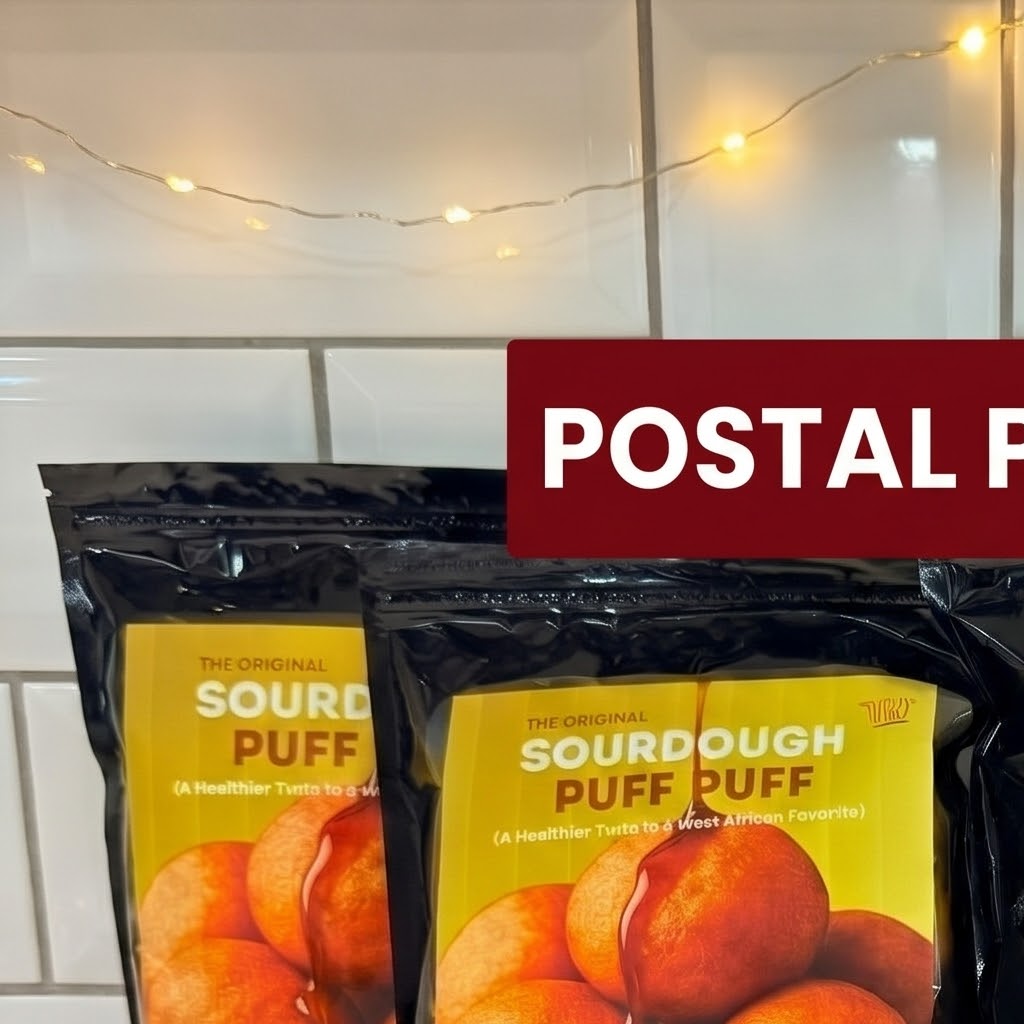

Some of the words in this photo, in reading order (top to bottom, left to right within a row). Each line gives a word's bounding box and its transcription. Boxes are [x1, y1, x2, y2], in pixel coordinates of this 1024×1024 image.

[200, 657, 232, 672] THE
[238, 657, 327, 673] ORIGINAL
[528, 717, 559, 730] THE
[563, 710, 648, 727] ORIGINAL
[234, 729, 359, 767] PUFF
[520, 724, 844, 772] SOURDOUGH
[555, 772, 674, 813] PUFF
[699, 766, 814, 802] PUFF
[493, 830, 512, 847] (A
[516, 824, 592, 844] Healthier
[643, 819, 659, 833] to
[678, 815, 720, 831] West
